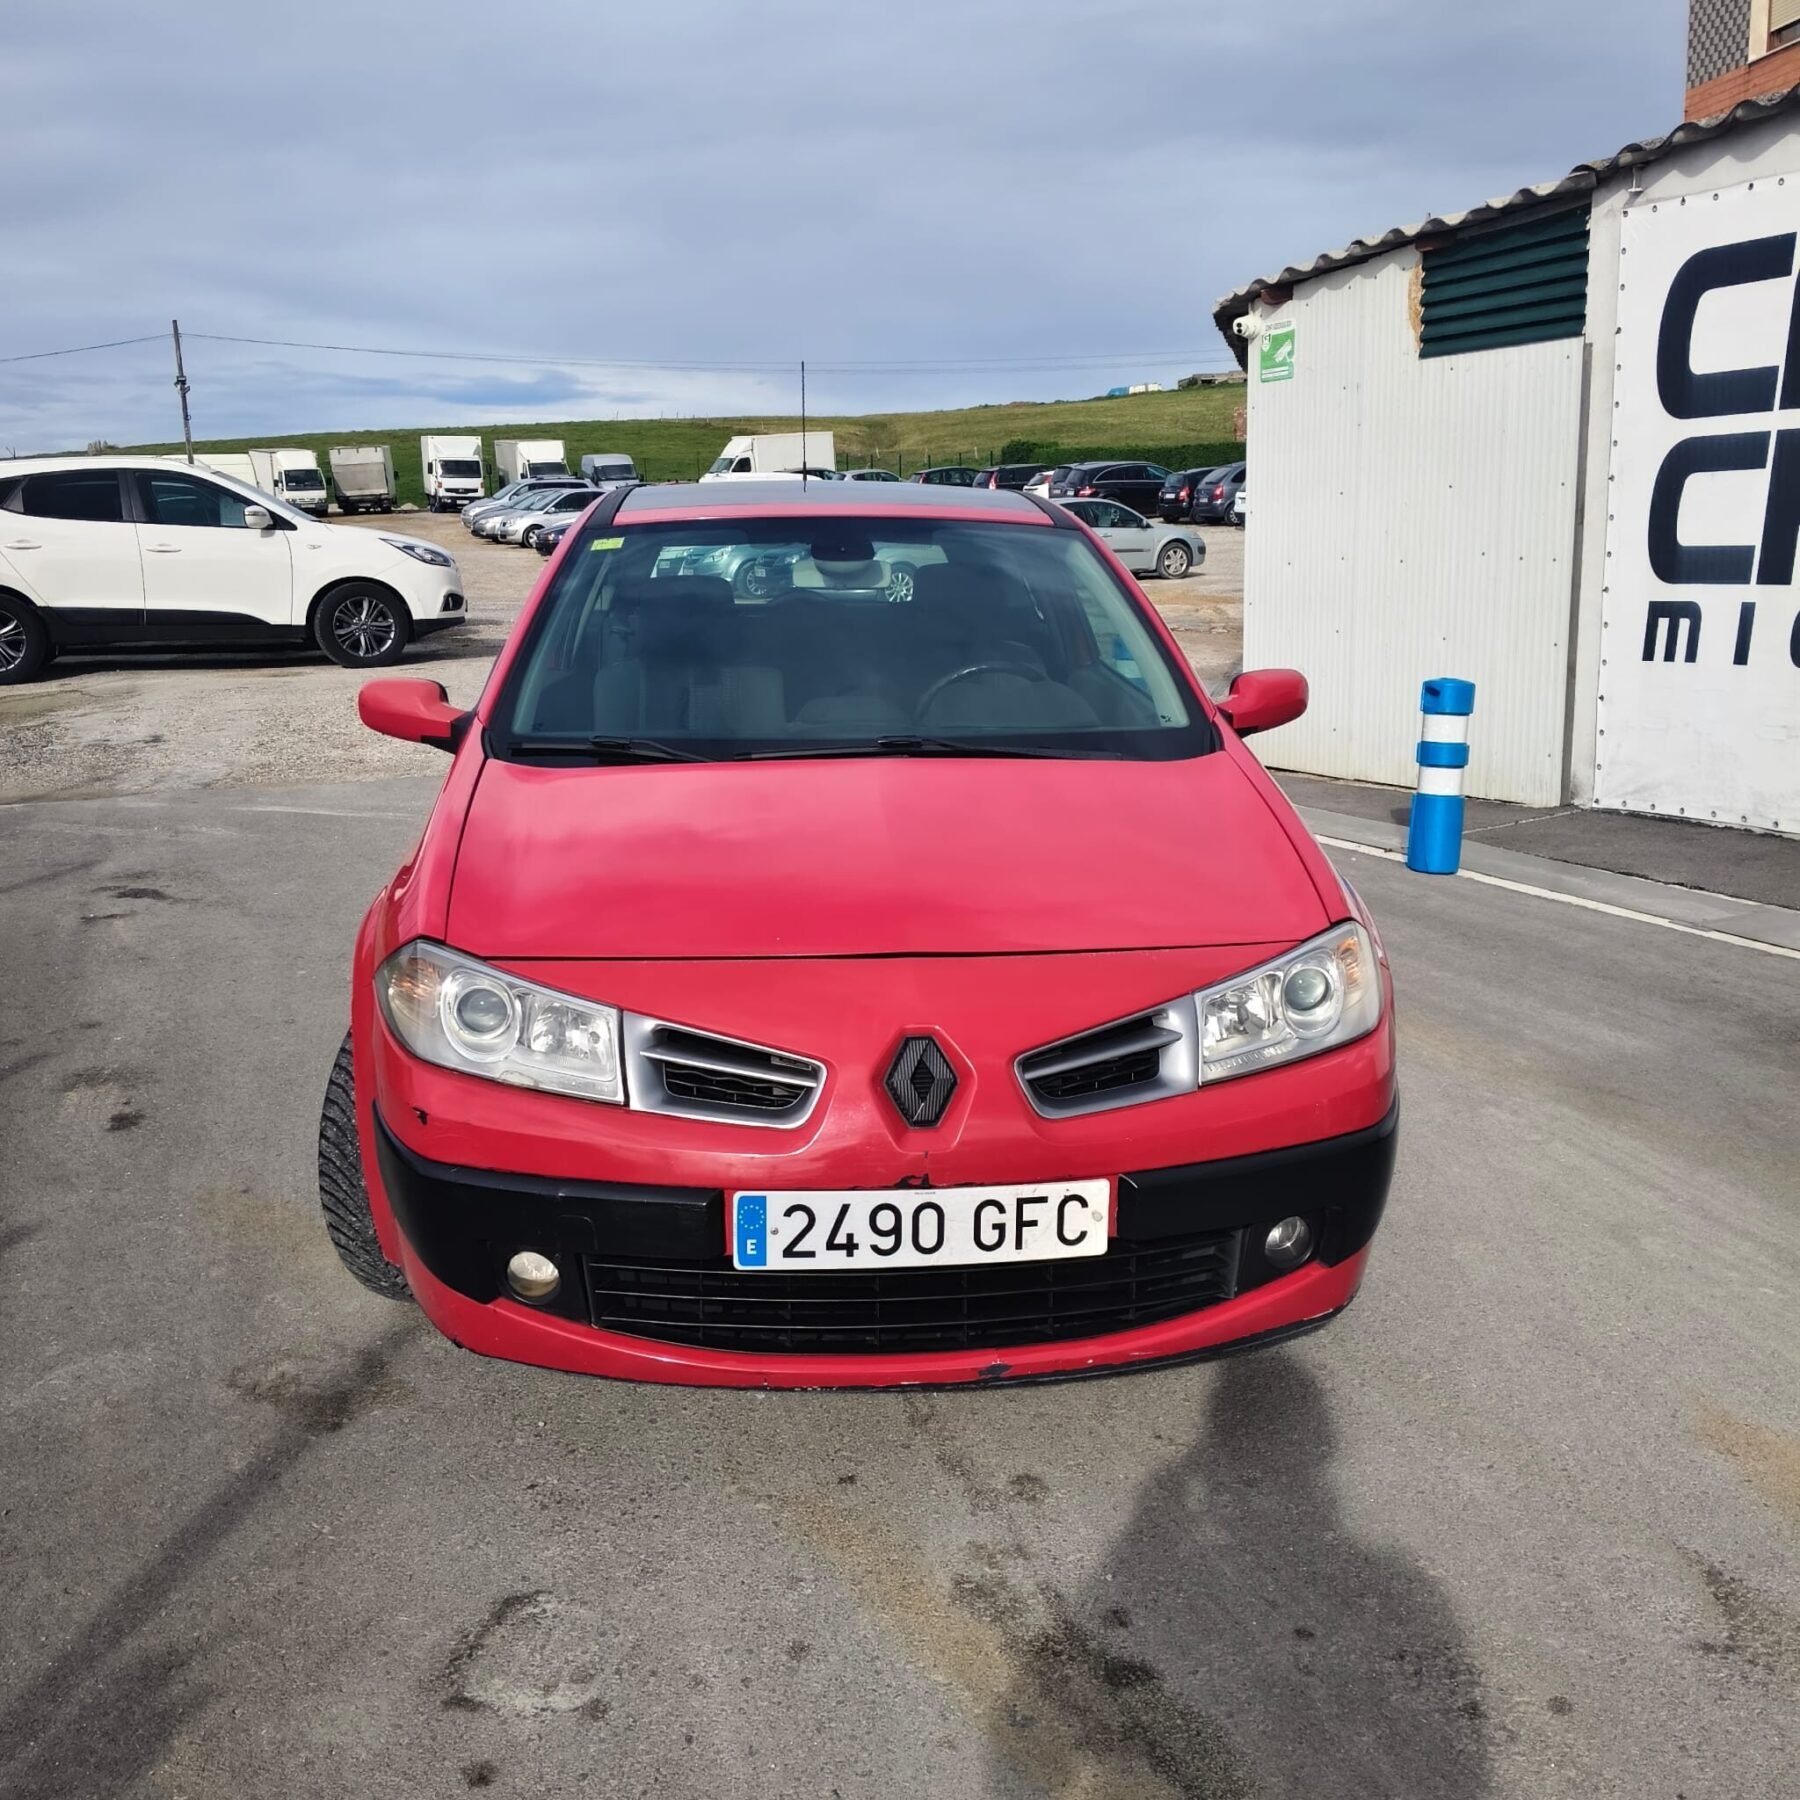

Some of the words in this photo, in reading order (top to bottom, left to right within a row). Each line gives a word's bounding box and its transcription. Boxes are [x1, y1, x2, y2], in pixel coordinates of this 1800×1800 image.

[1656, 231, 1800, 420] C
[746, 1239, 757, 1255] E
[782, 1201, 945, 1259] 2490
[973, 1193, 1089, 1252] GFC
